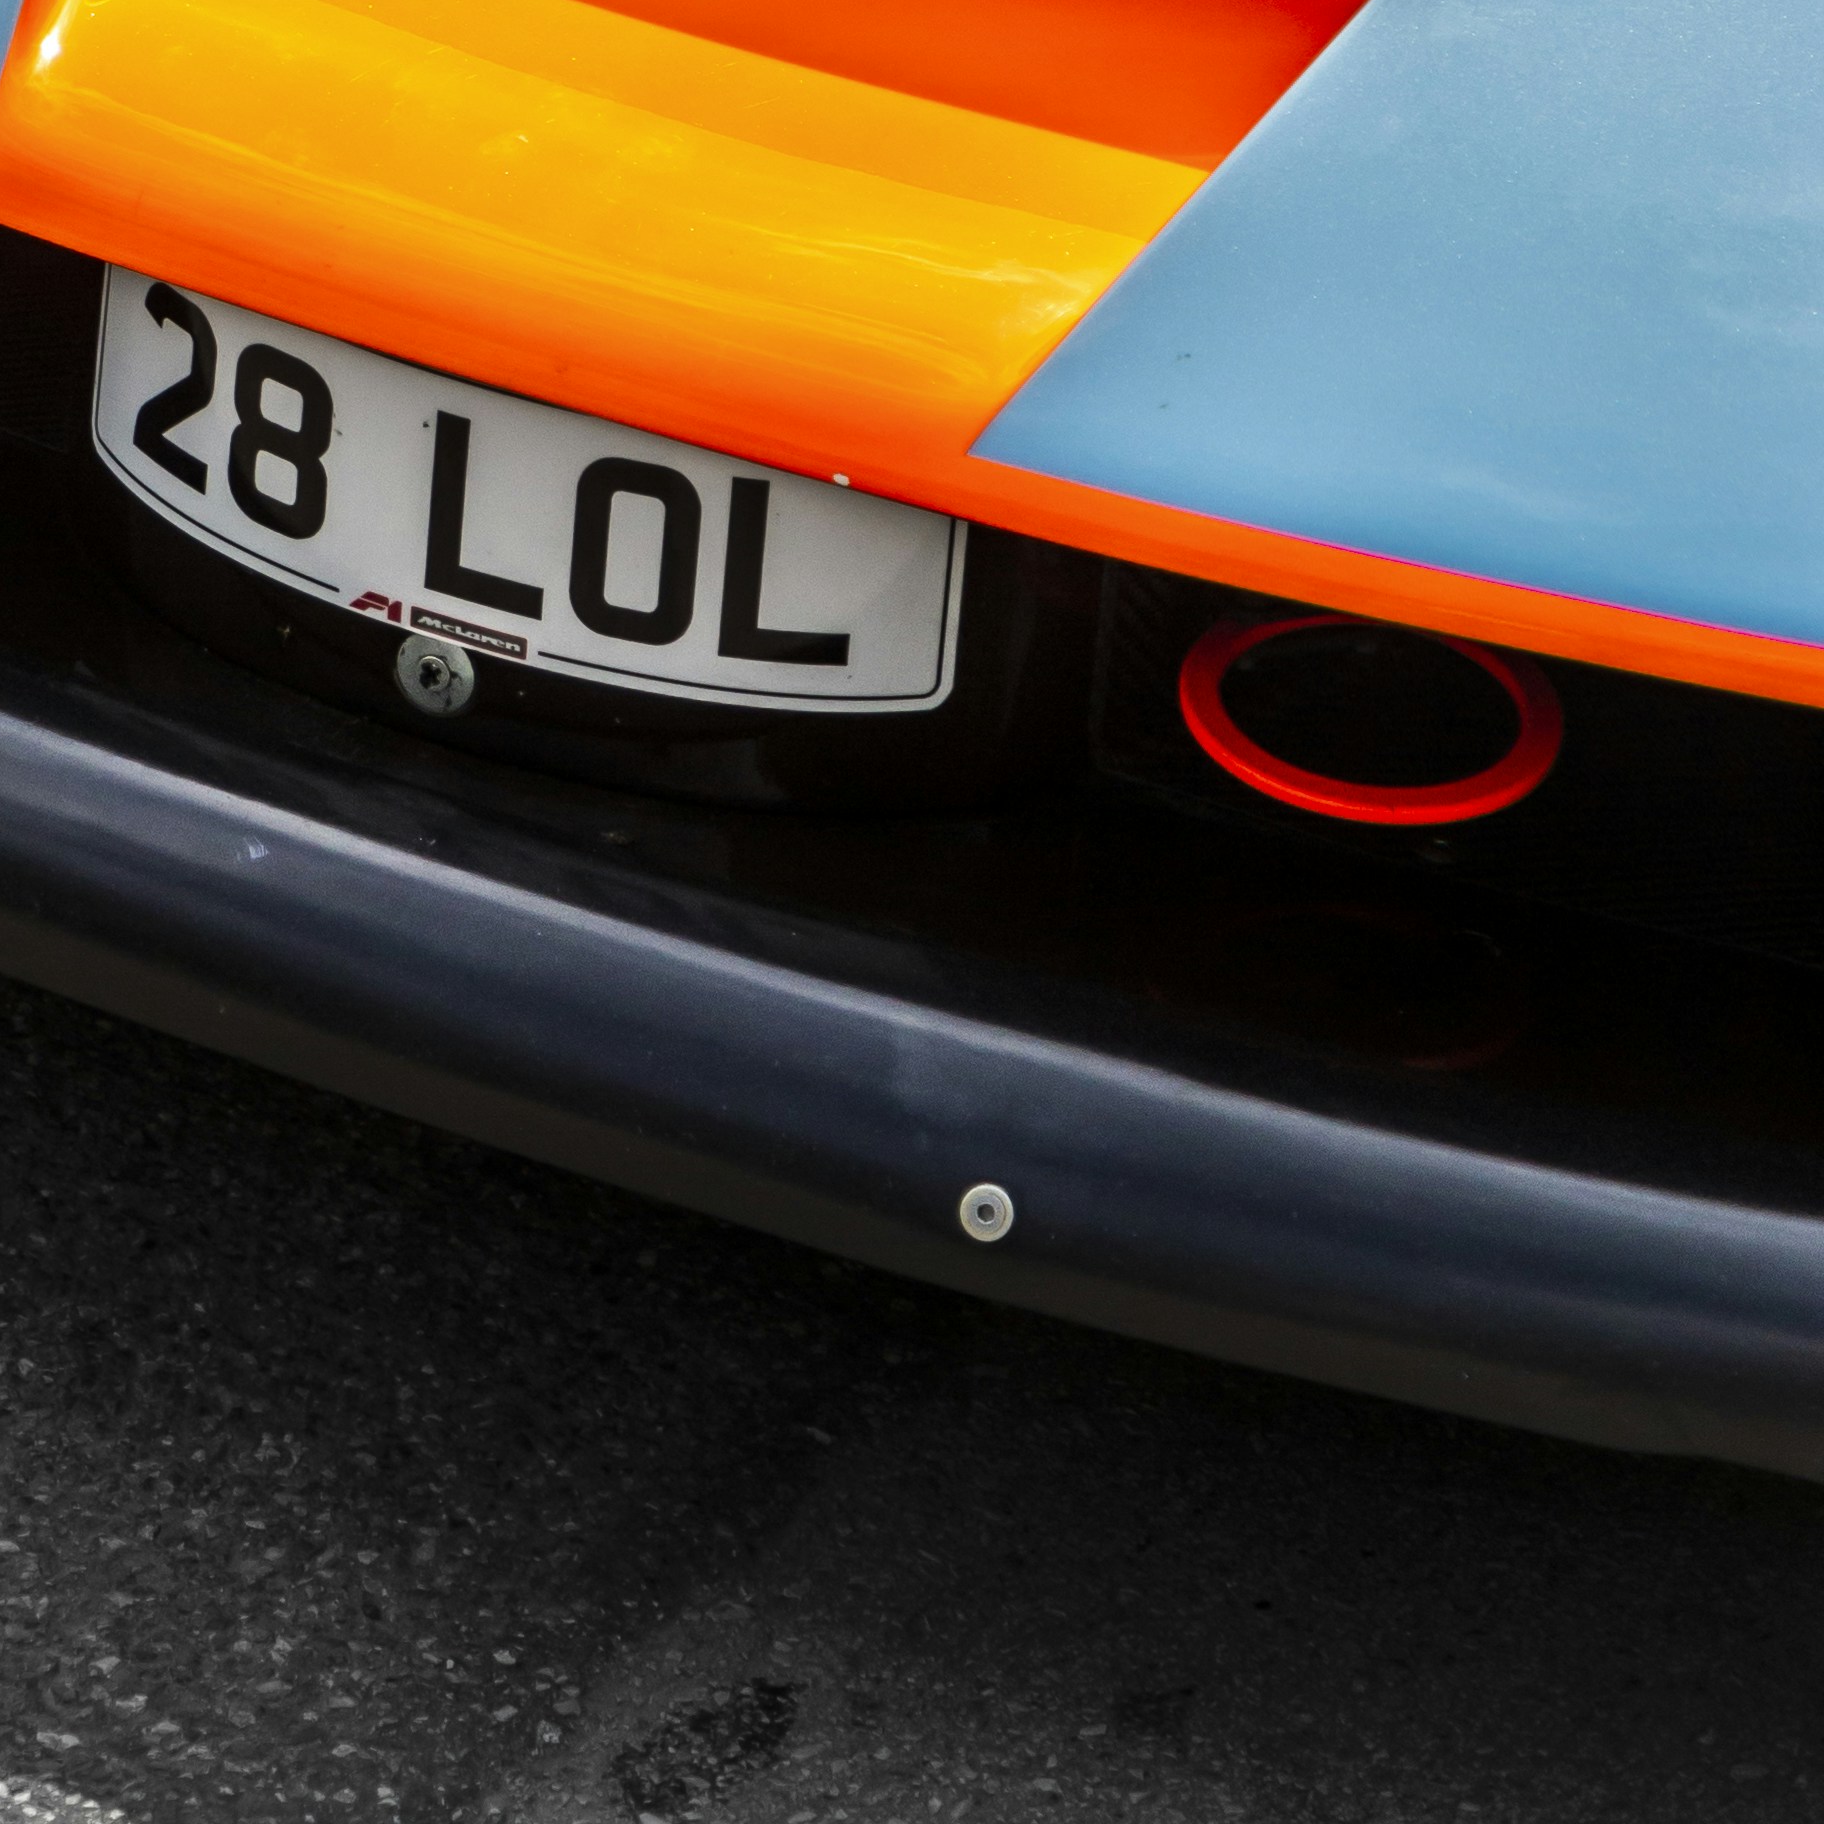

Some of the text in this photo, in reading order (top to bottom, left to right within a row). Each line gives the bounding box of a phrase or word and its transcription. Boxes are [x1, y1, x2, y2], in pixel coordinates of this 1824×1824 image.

[131, 282, 851, 668] 28 LOL
[417, 616, 522, 653] McLaren
